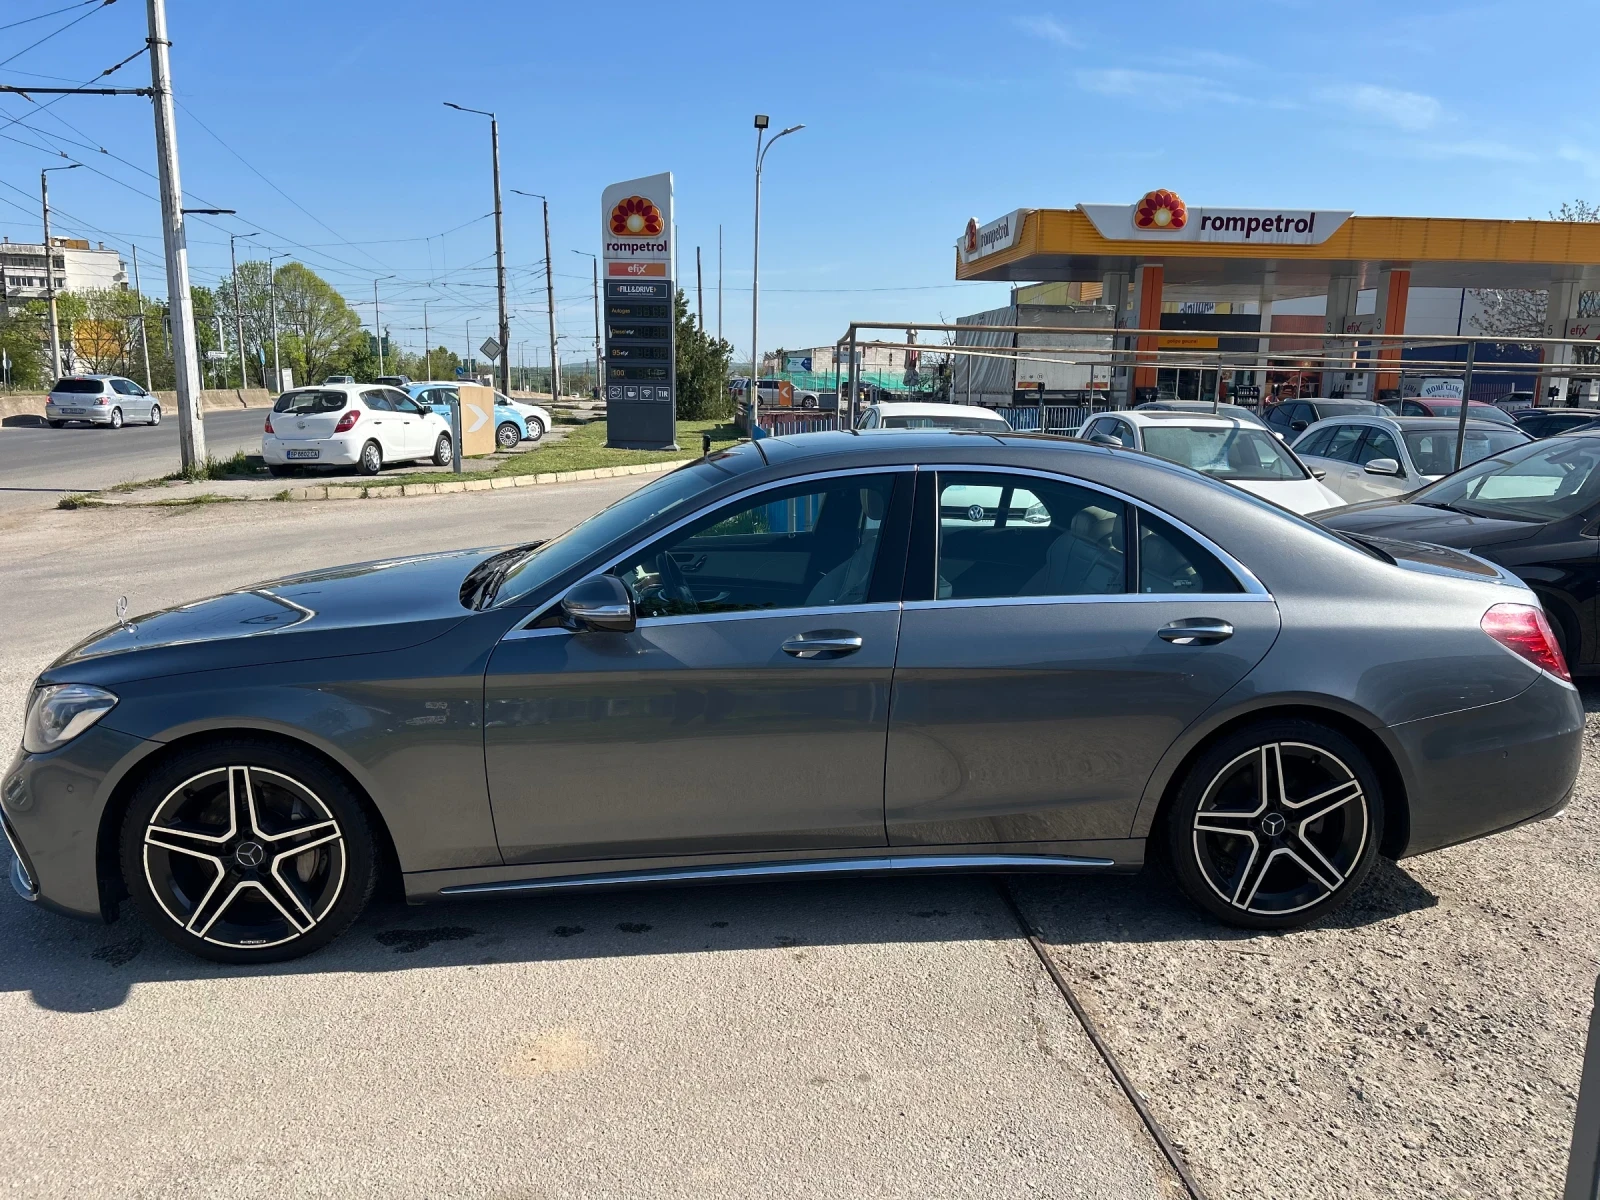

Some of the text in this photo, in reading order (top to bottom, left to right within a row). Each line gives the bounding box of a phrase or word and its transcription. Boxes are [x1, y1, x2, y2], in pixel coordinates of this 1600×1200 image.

[1201, 212, 1316, 239] rompetrol
[981, 217, 1009, 249] rompetrol
[606, 240, 667, 255] rompetrol
[627, 264, 647, 275] efix
[619, 285, 654, 293] FILL&DRIVE
[1326, 321, 1332, 333] 3
[1346, 321, 1363, 333] efix
[1376, 318, 1382, 330] 3
[1547, 324, 1553, 336] 5
[1570, 324, 1590, 338] efix
[1425, 384, 1462, 396] HOME CLIMA
